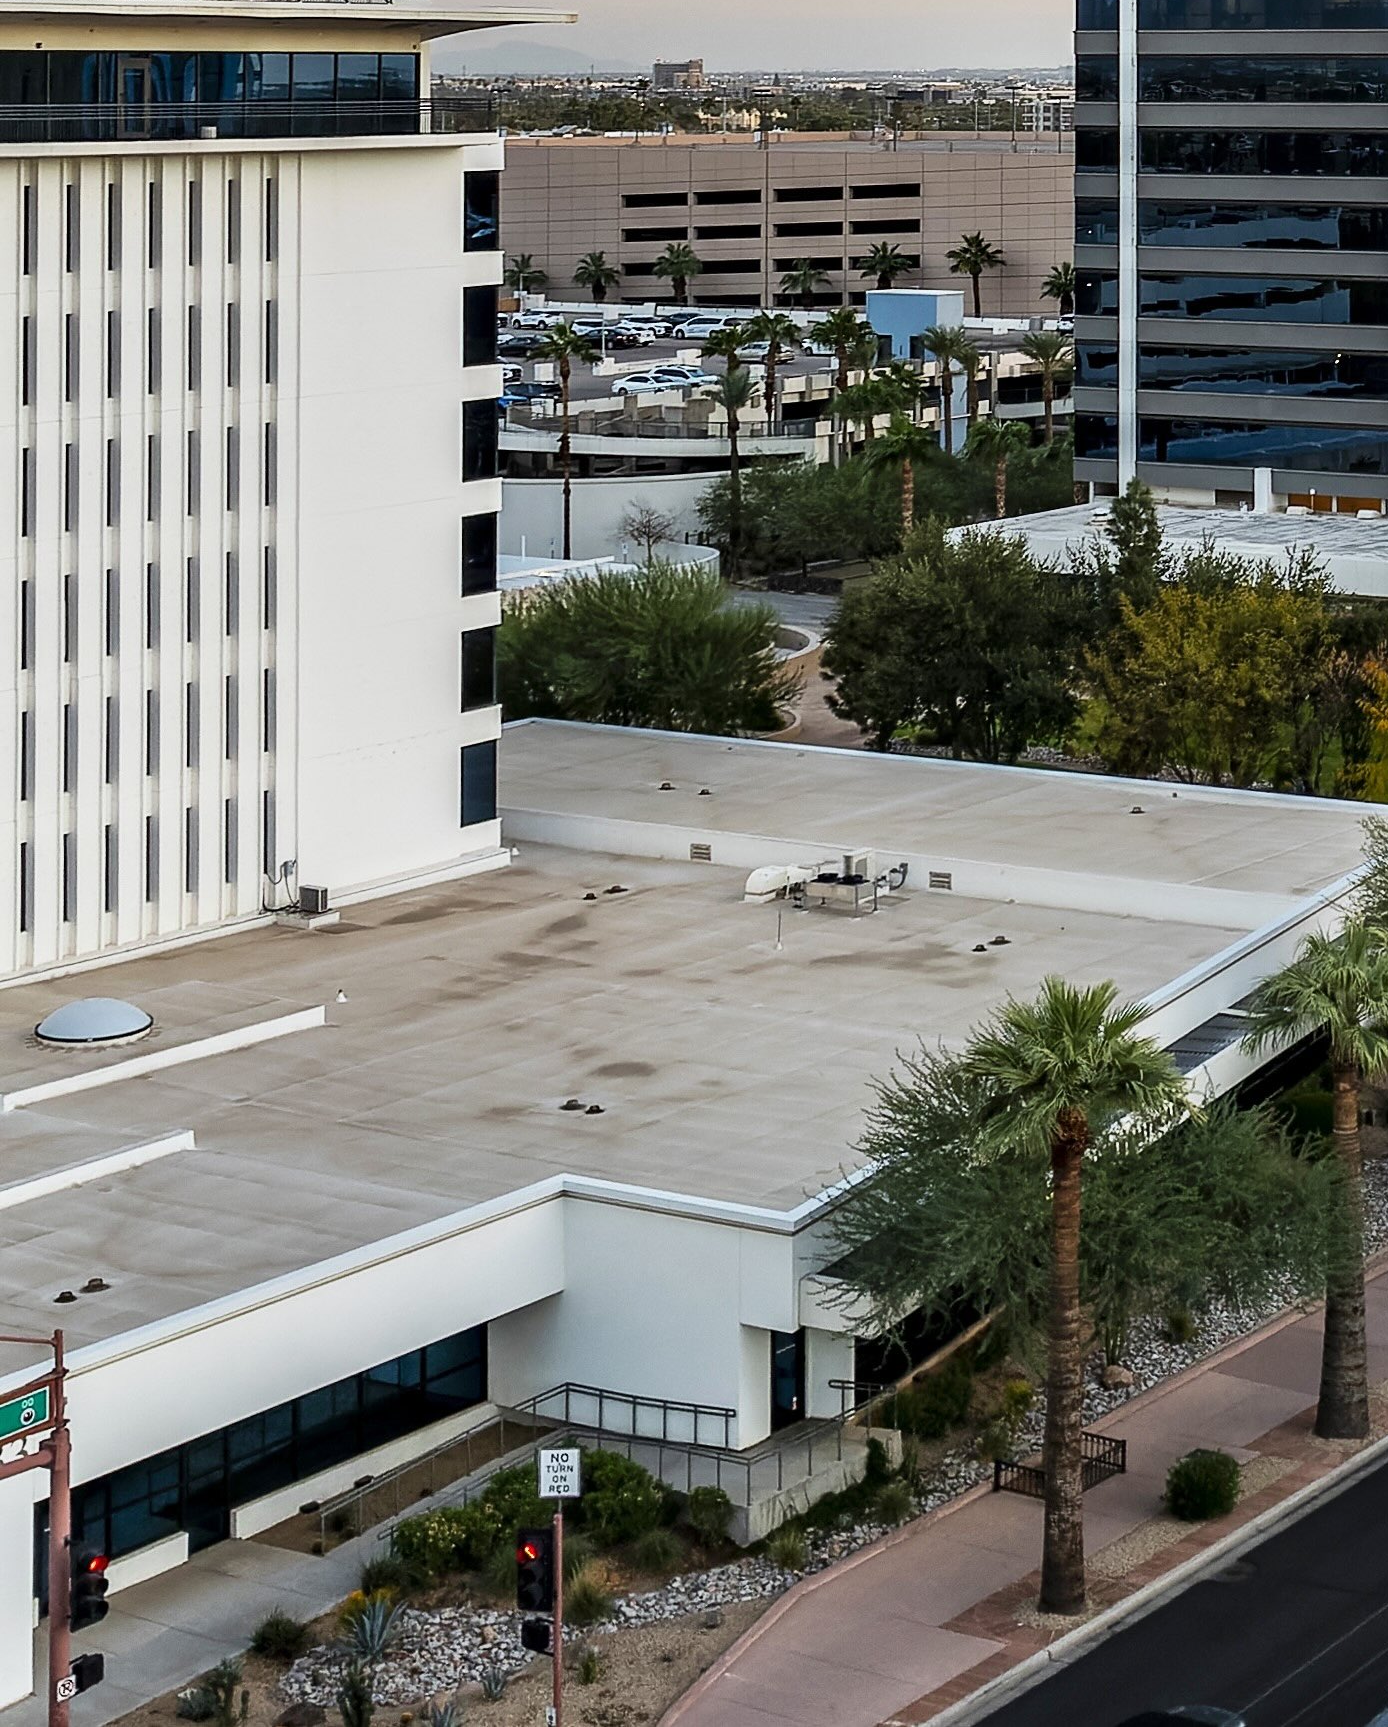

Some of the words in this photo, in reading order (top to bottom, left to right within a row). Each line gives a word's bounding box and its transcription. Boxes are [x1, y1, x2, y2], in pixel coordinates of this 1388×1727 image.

[550, 1452, 569, 1464] NO
[546, 1464, 574, 1474] TURN
[552, 1474, 567, 1484] ON
[549, 1484, 570, 1494] RED
